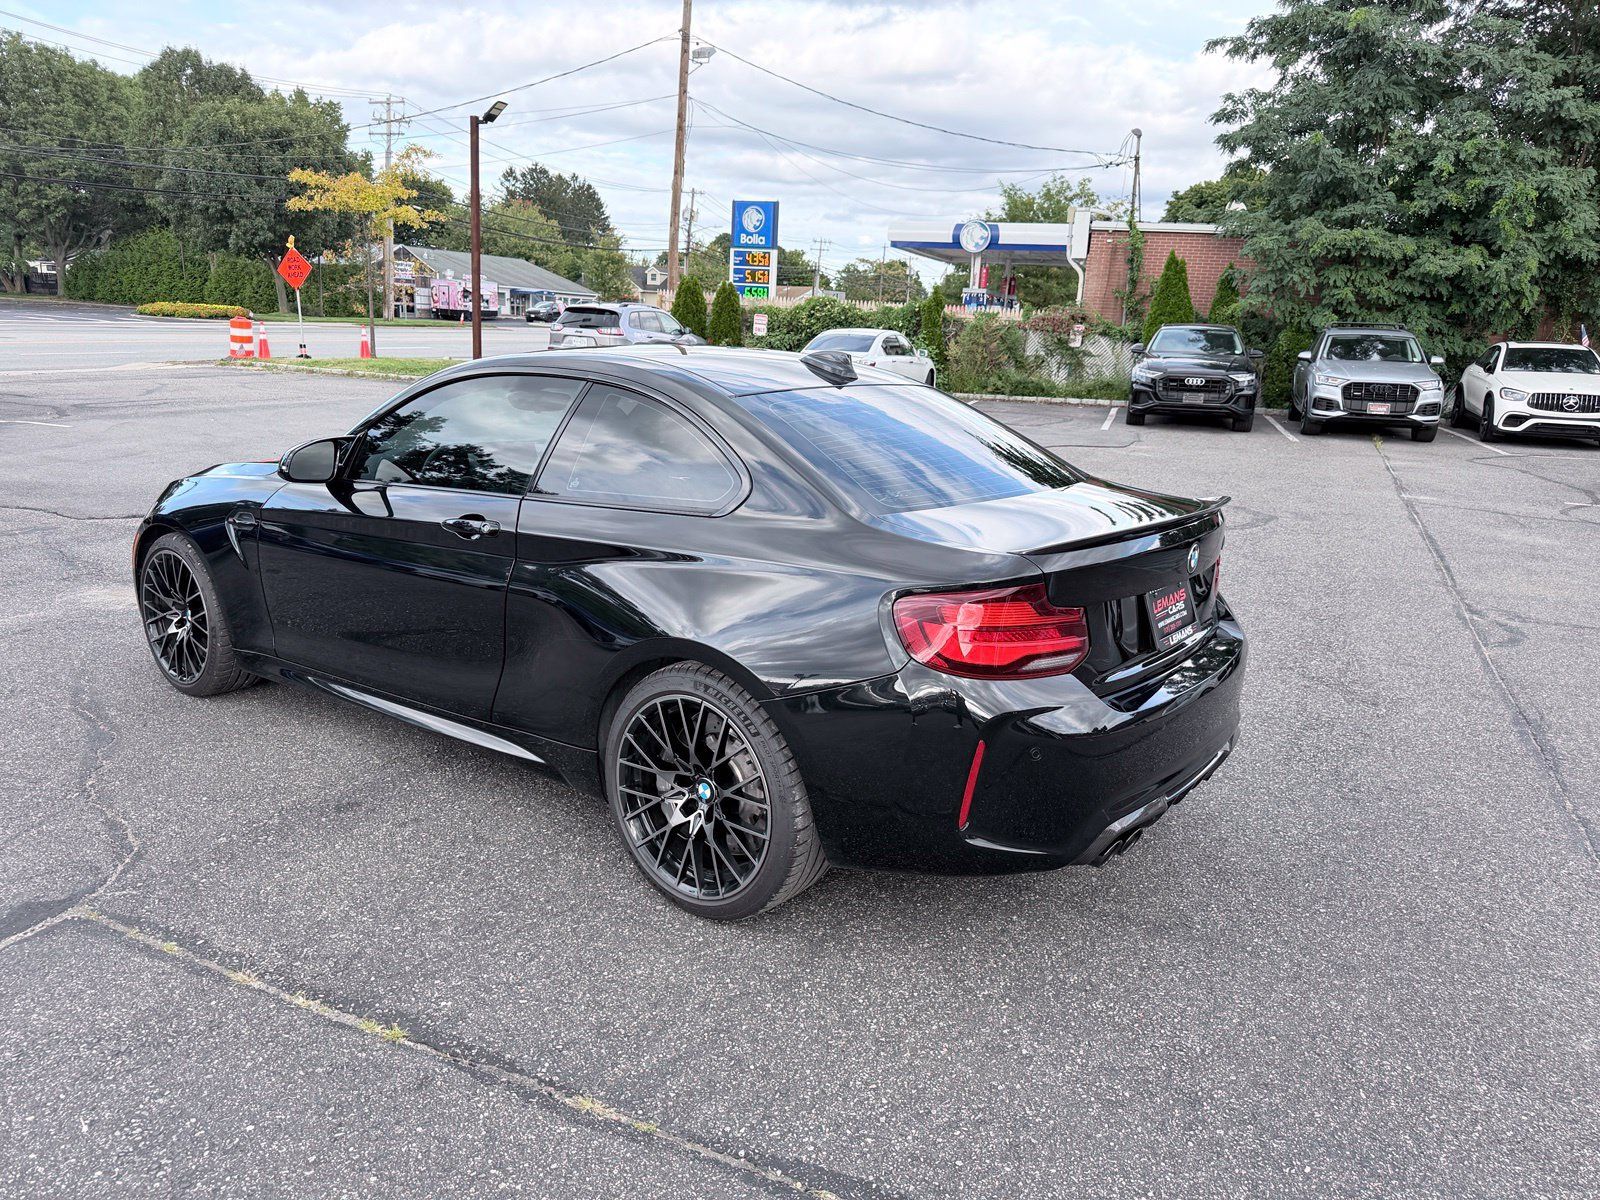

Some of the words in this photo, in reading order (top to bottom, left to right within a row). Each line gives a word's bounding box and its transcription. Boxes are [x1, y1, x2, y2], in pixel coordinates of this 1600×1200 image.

[740, 233, 766, 245] Bolla
[1152, 588, 1187, 614] LEMANS
[1167, 600, 1185, 615] CARS
[1168, 625, 1194, 645] LEMANS
[703, 685, 759, 735] MICHELIN
